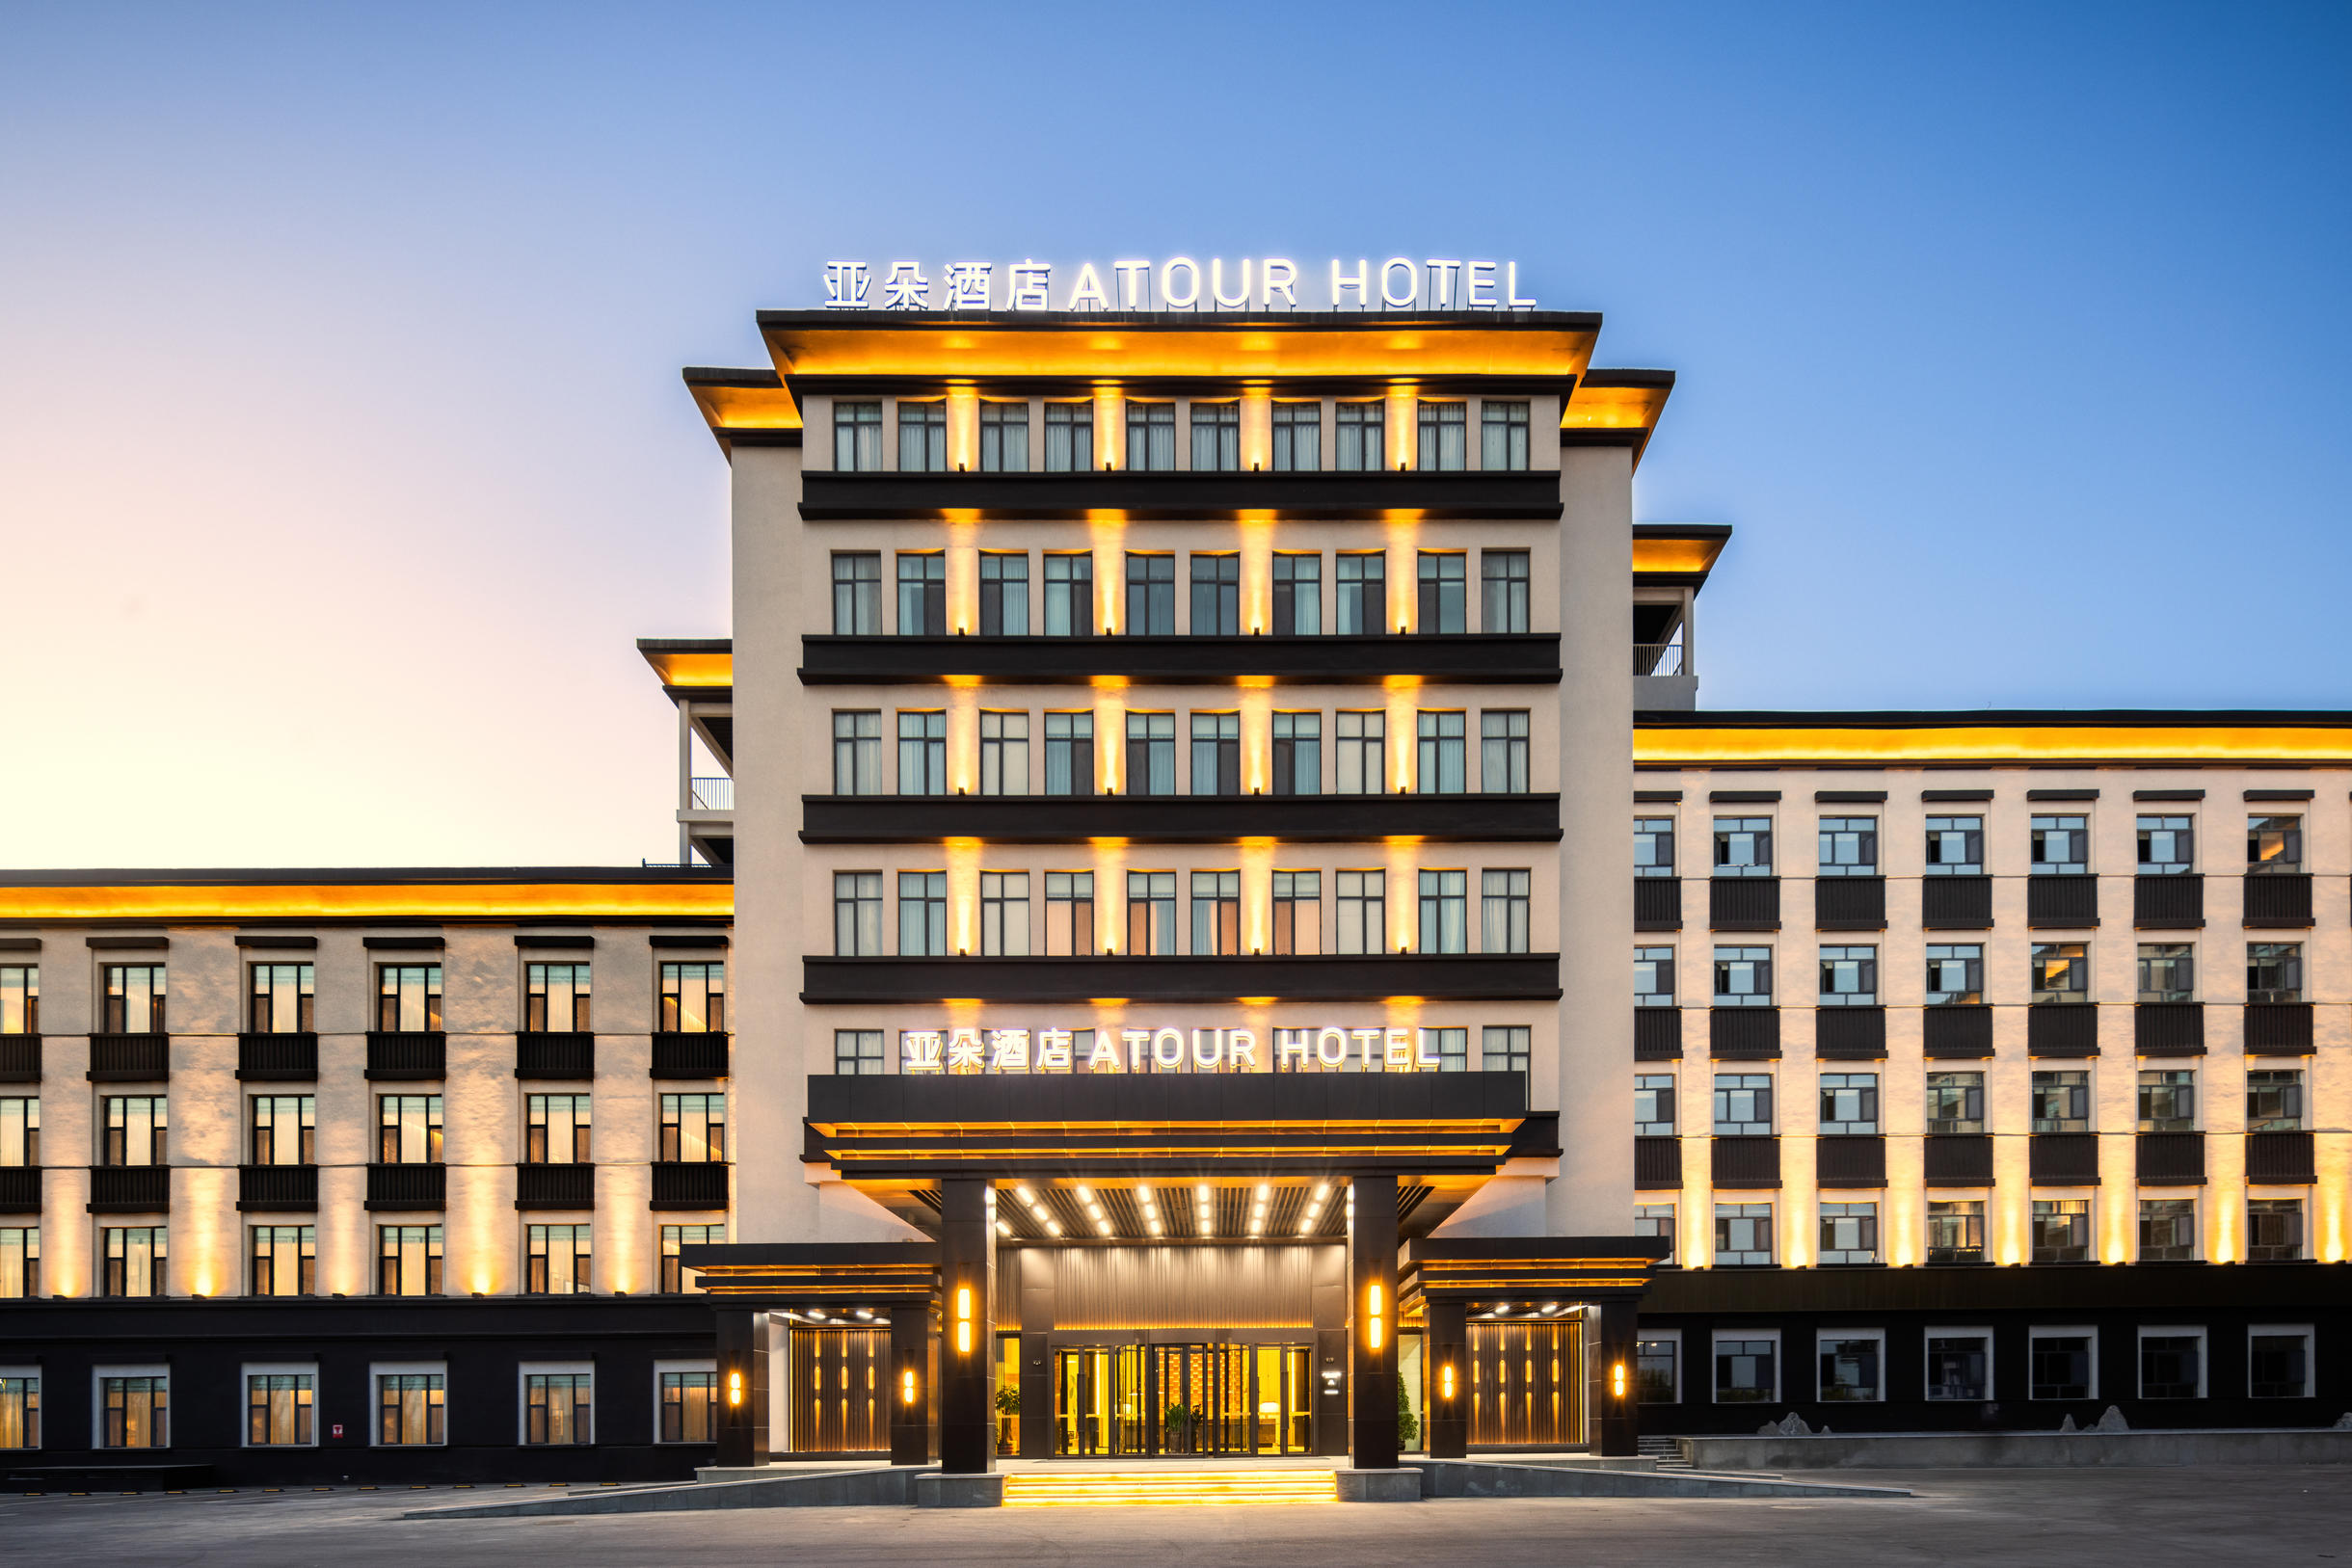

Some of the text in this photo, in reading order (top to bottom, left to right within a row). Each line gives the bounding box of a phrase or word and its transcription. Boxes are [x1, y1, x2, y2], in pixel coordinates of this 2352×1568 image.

[823, 257, 1537, 309] 亚朵酒店 ATOUR HOTEL
[906, 1026, 1440, 1070] 亚朵酒店 ATOUR HOTEL
